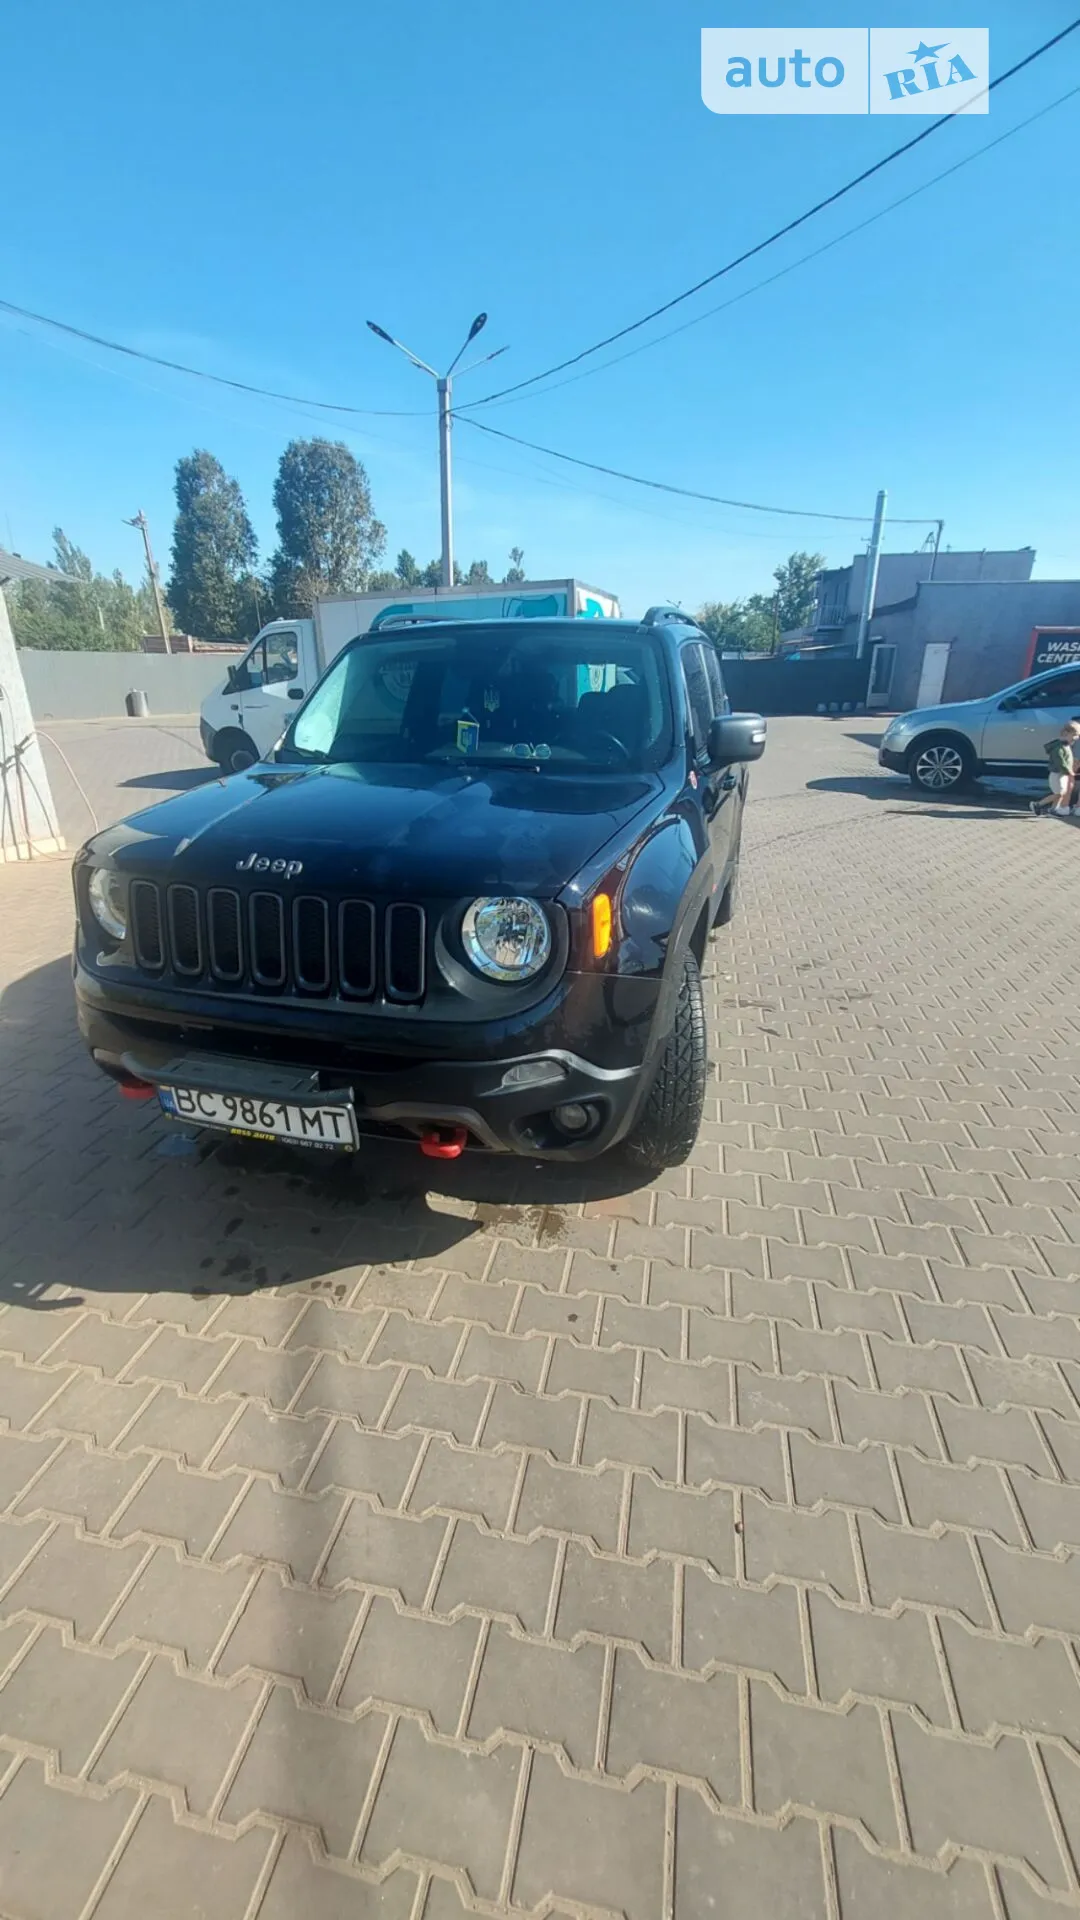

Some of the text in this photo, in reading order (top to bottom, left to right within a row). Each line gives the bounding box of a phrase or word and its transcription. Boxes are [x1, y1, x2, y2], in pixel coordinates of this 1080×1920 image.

[1047, 641, 1080, 653] WAS
[235, 852, 303, 880] Jeep
[176, 1088, 217, 1117] BC
[221, 1095, 291, 1132] 9861
[300, 1107, 345, 1138] MT
